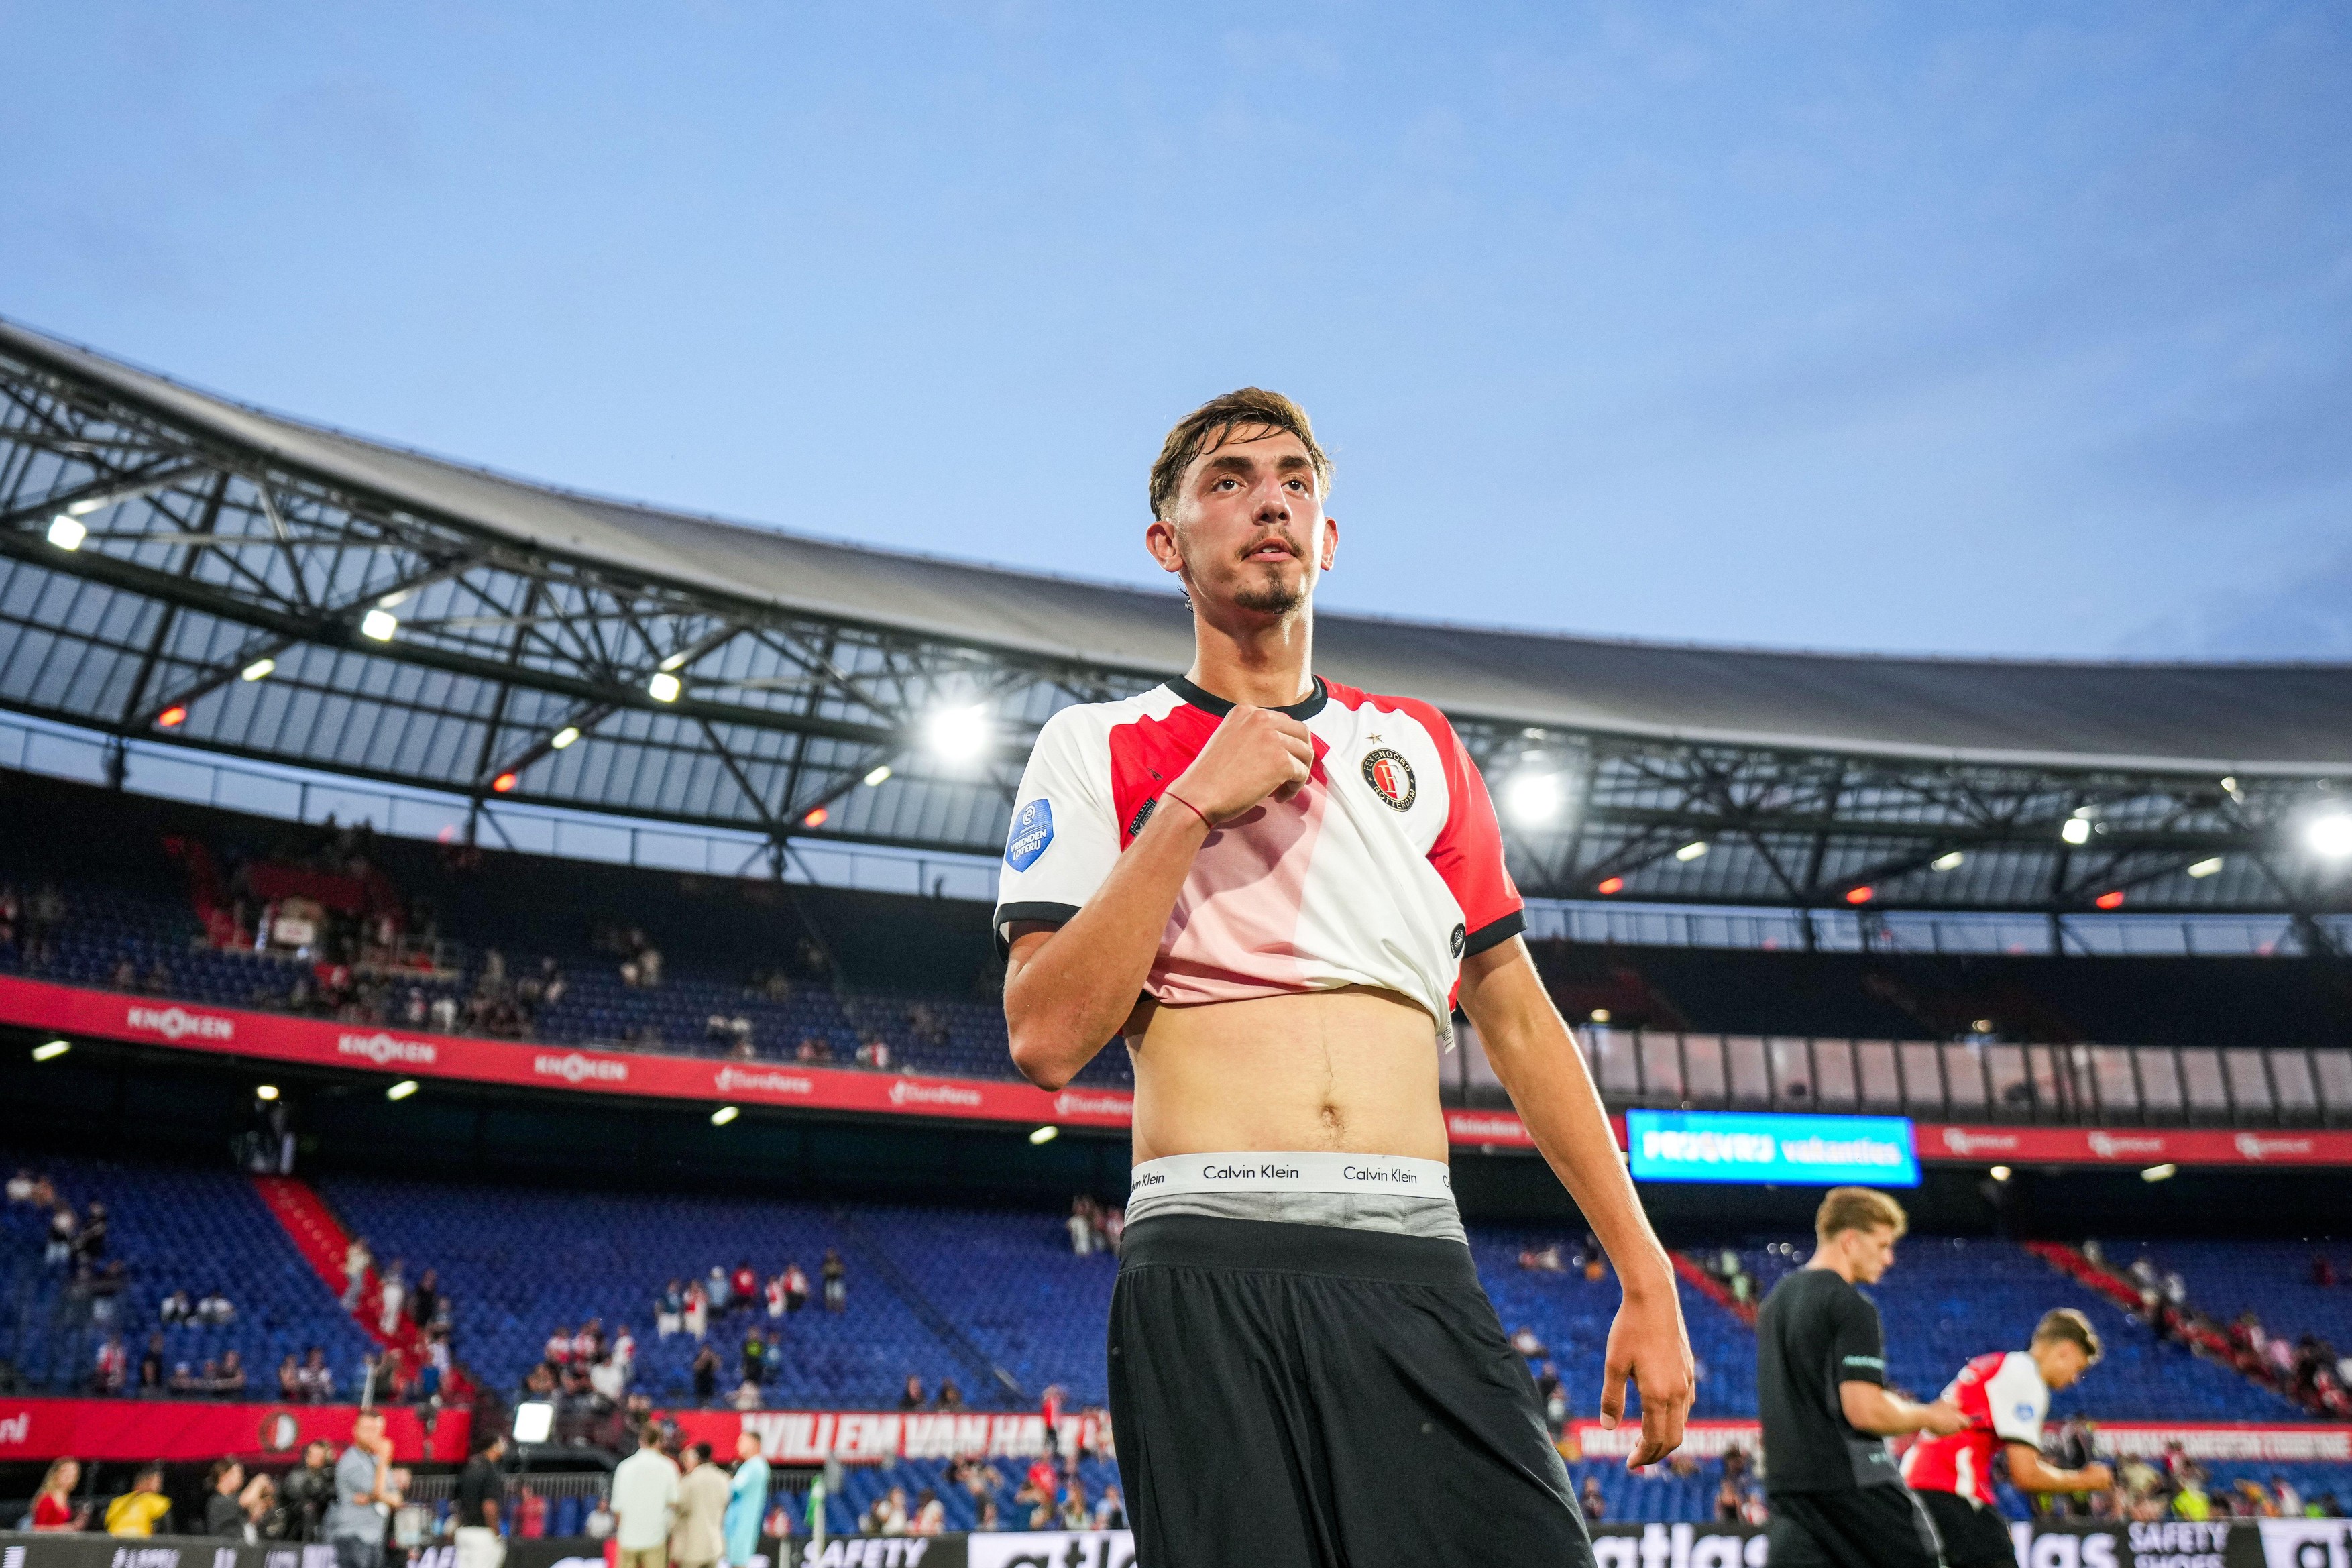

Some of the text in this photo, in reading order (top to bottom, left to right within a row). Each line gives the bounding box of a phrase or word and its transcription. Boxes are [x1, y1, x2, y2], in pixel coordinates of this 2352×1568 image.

[1364, 751, 1410, 771] FEYENOORD
[1373, 786, 1416, 809] ROTTERDAM
[1011, 829, 1046, 852] VRIENDEN
[1013, 840, 1041, 861] LOTERIJ
[1142, 1171, 1164, 1186] Klein
[1203, 1164, 1298, 1179] Calvin Klein
[1343, 1166, 1417, 1184] Calvin Klein
[905, 1414, 989, 1459] VAN
[2129, 1522, 2230, 1553] SAFETY
